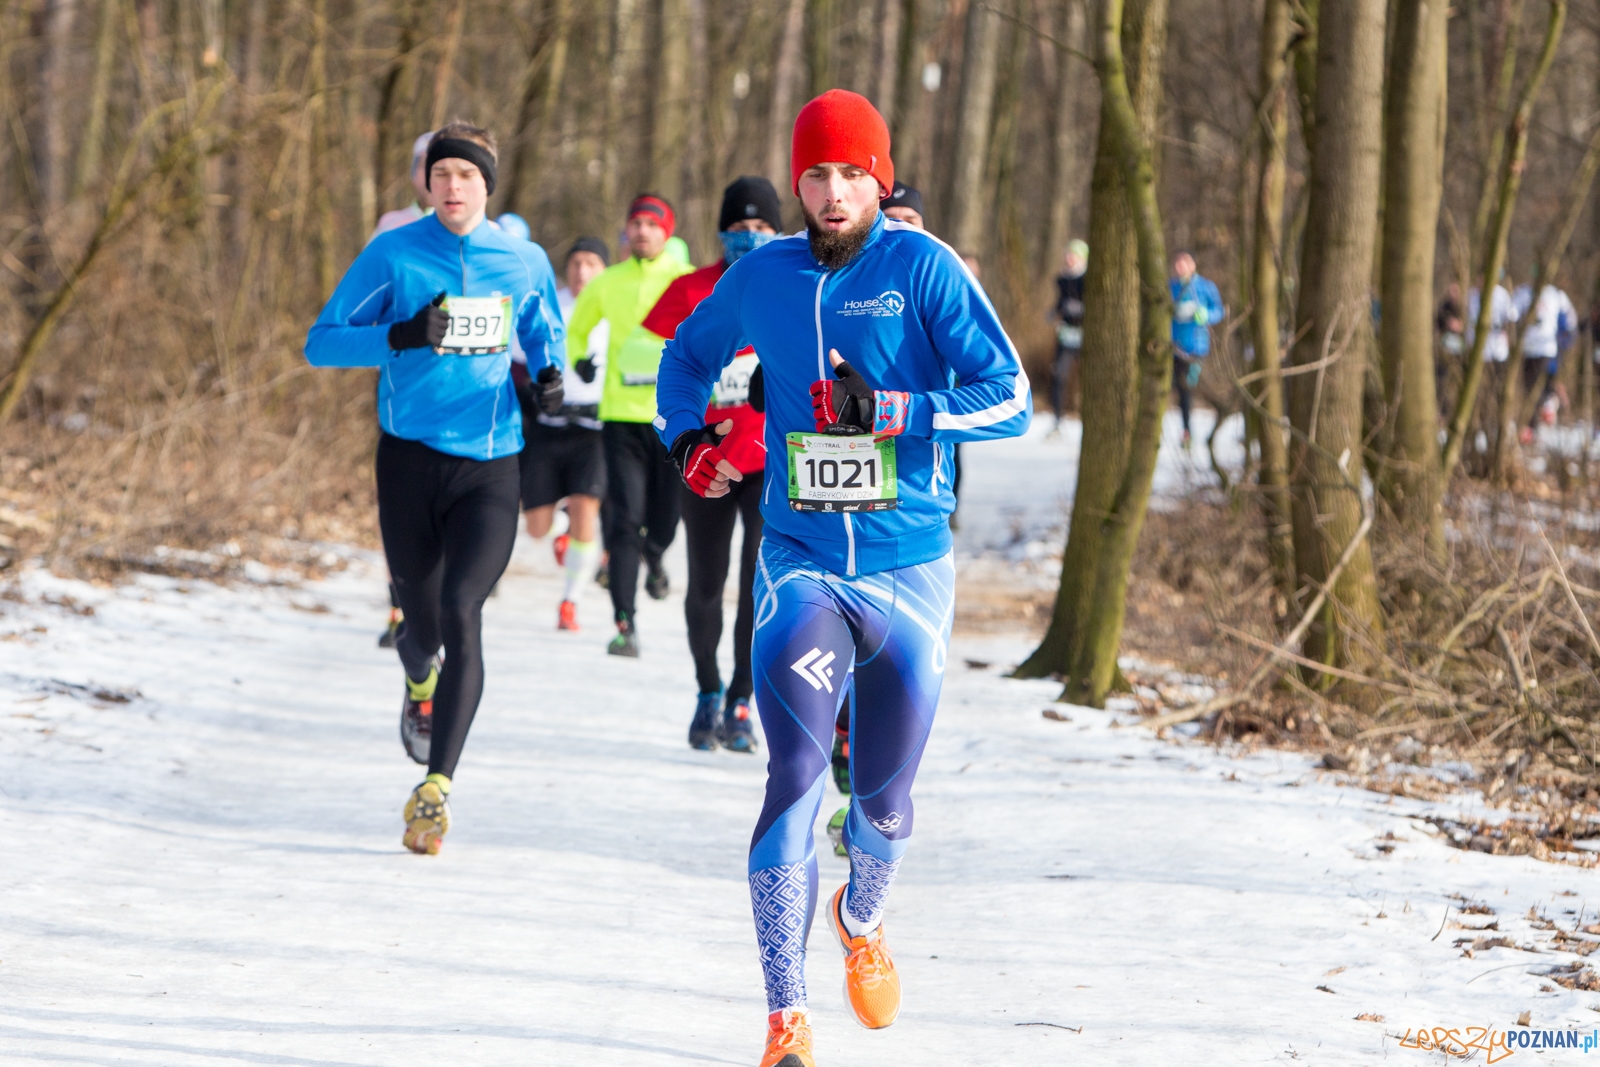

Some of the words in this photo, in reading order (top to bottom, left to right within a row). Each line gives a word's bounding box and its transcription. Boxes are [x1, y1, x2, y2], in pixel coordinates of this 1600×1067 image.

[448, 315, 501, 336] 1397
[805, 458, 876, 489] 1021
[808, 491, 855, 499] FABRYKOWY
[857, 491, 875, 499] DZIK
